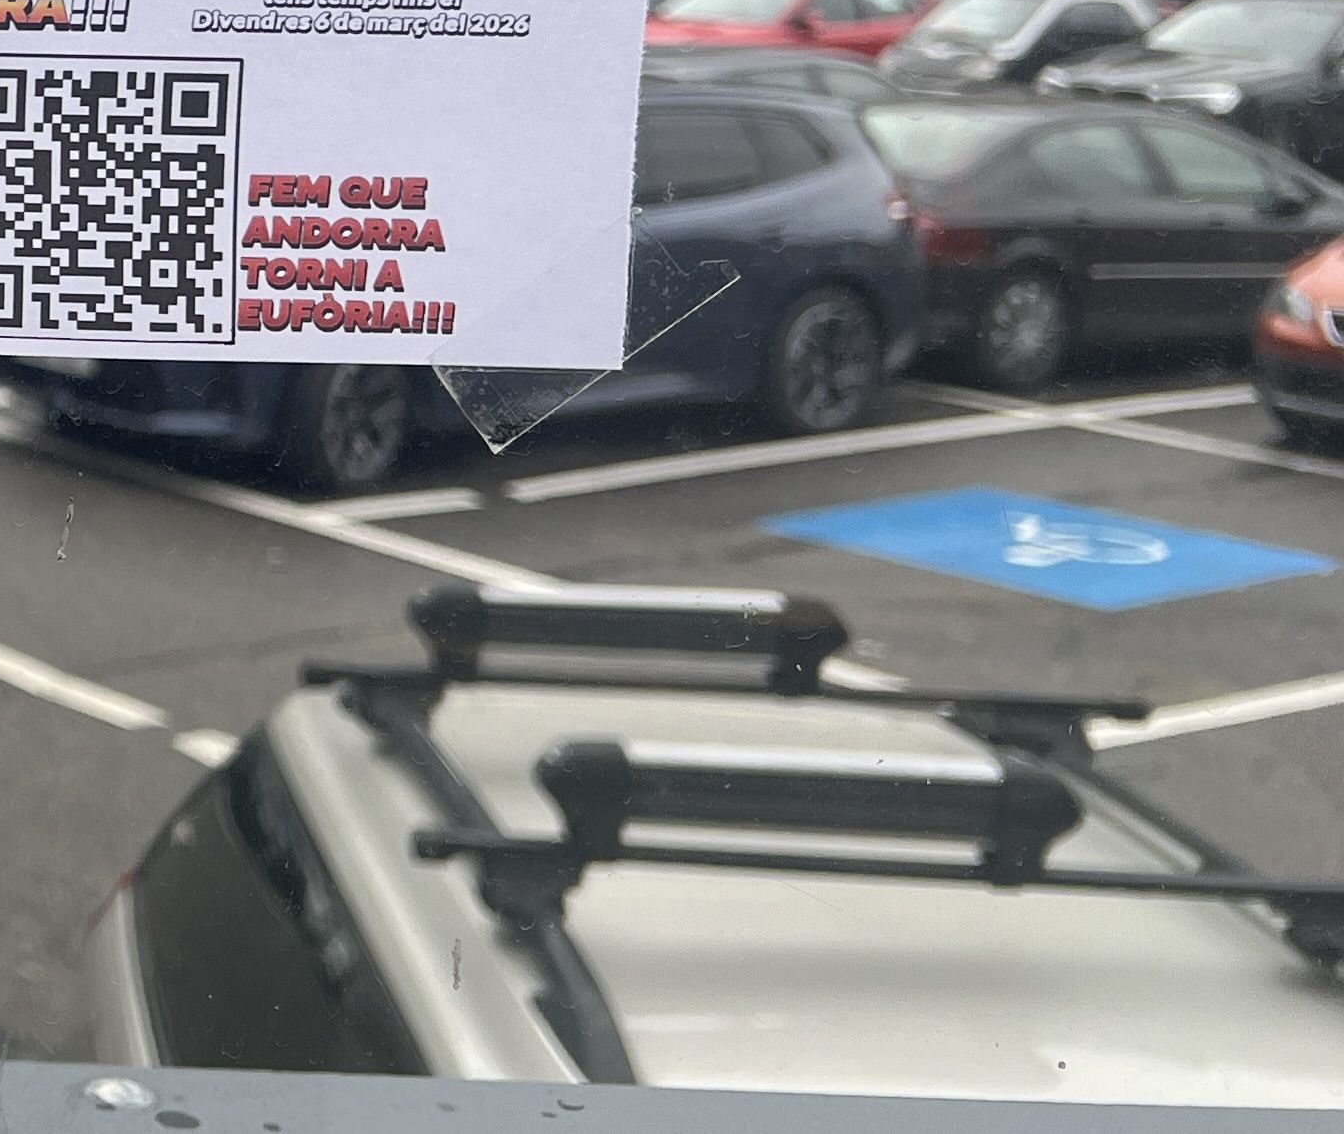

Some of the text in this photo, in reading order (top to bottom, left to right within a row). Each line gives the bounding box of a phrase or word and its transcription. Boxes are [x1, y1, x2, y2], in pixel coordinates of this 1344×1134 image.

[191, 9, 531, 39] Divendres 6 de març del 2026
[248, 174, 428, 210] FEM QUE
[241, 215, 445, 252] ANDORRA
[240, 256, 405, 292] TORNI A
[237, 293, 456, 334] EUFÒRIA!!!
